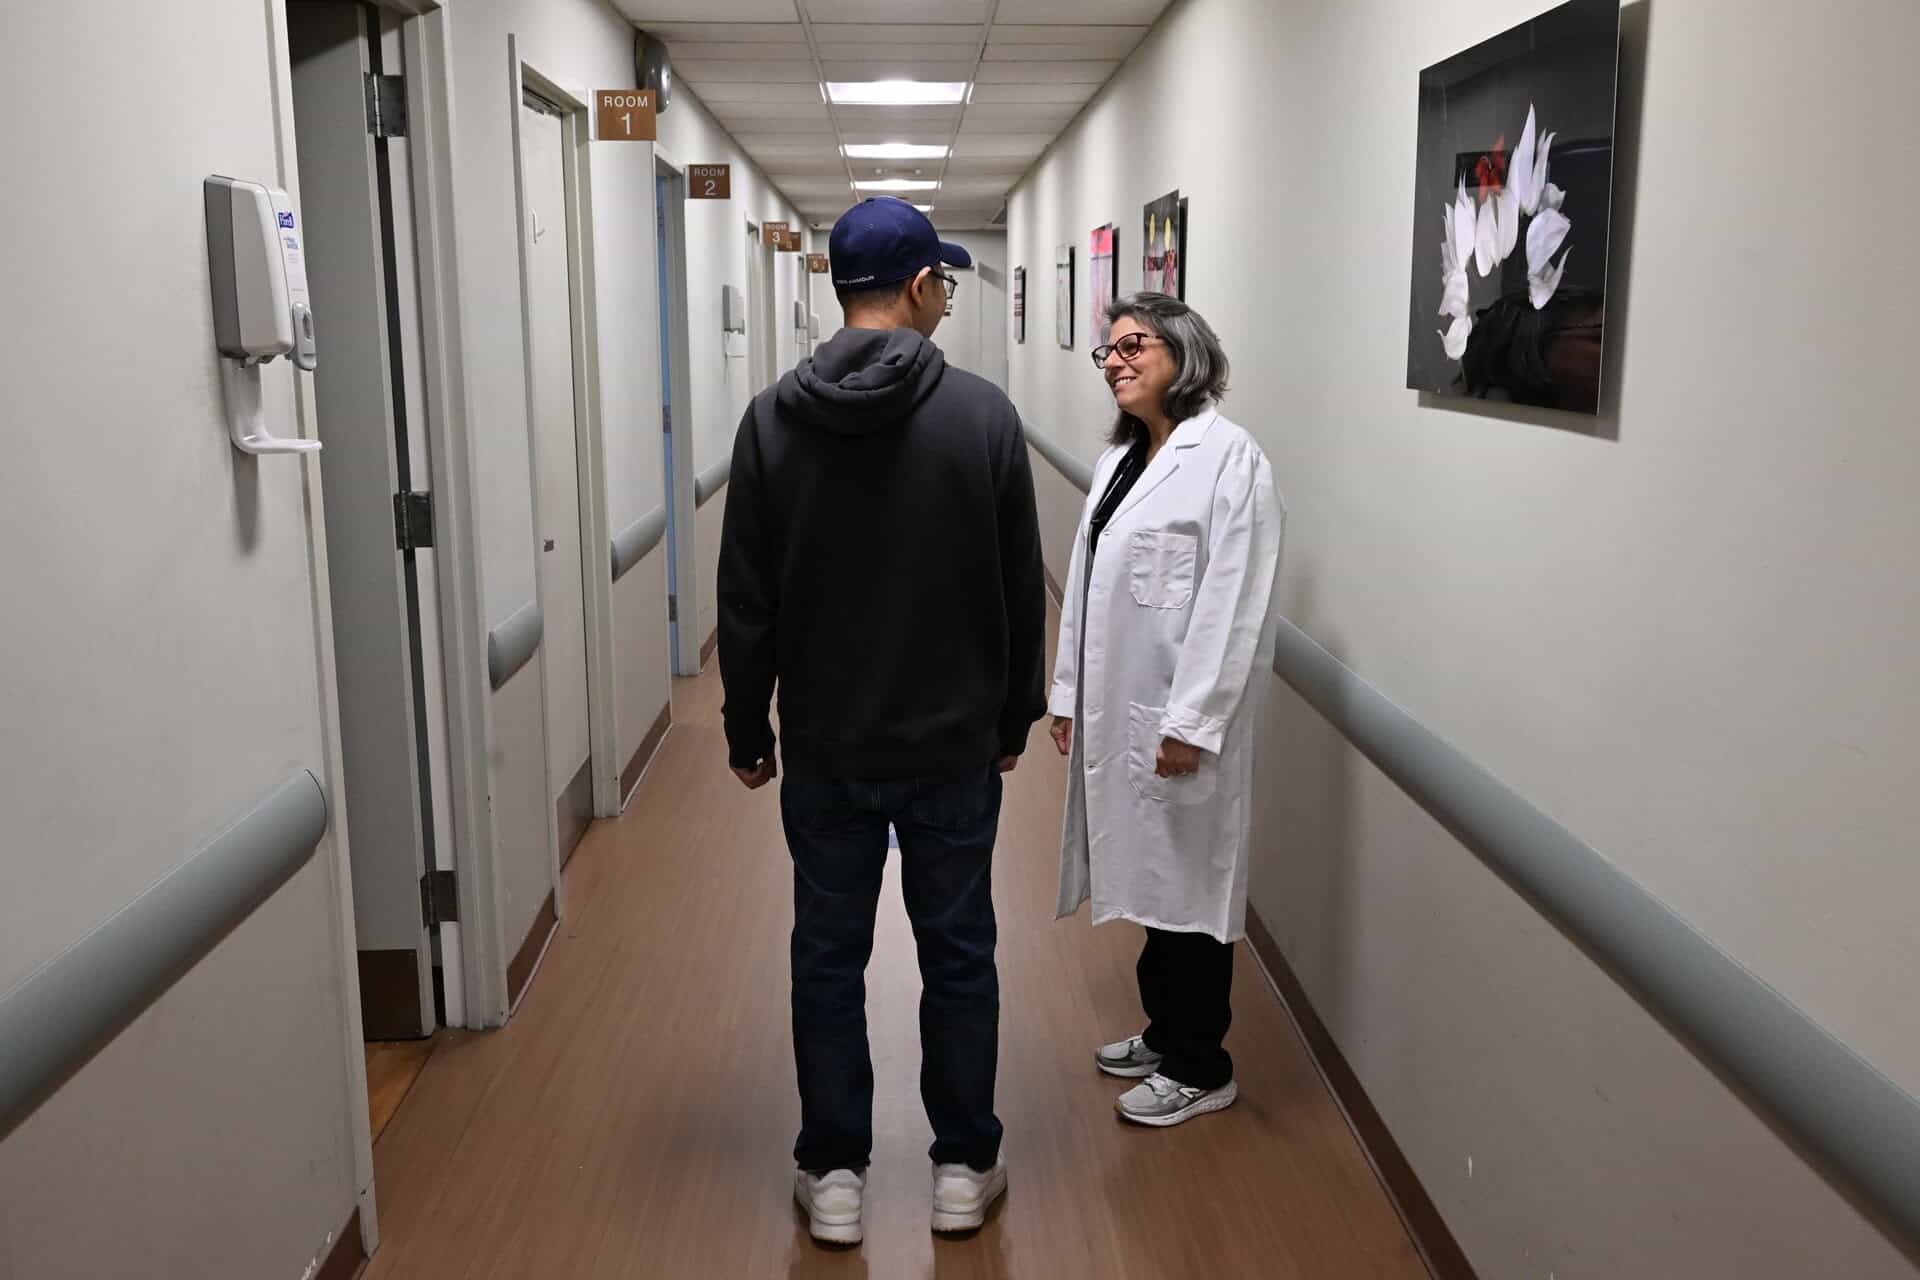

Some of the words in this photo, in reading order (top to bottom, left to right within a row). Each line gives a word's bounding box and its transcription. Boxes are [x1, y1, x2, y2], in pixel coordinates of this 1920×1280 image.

[604, 96, 648, 107] ROOM
[620, 112, 631, 135] 1
[694, 167, 725, 176] ROOM
[704, 180, 716, 196] 2
[772, 231, 780, 243] 3
